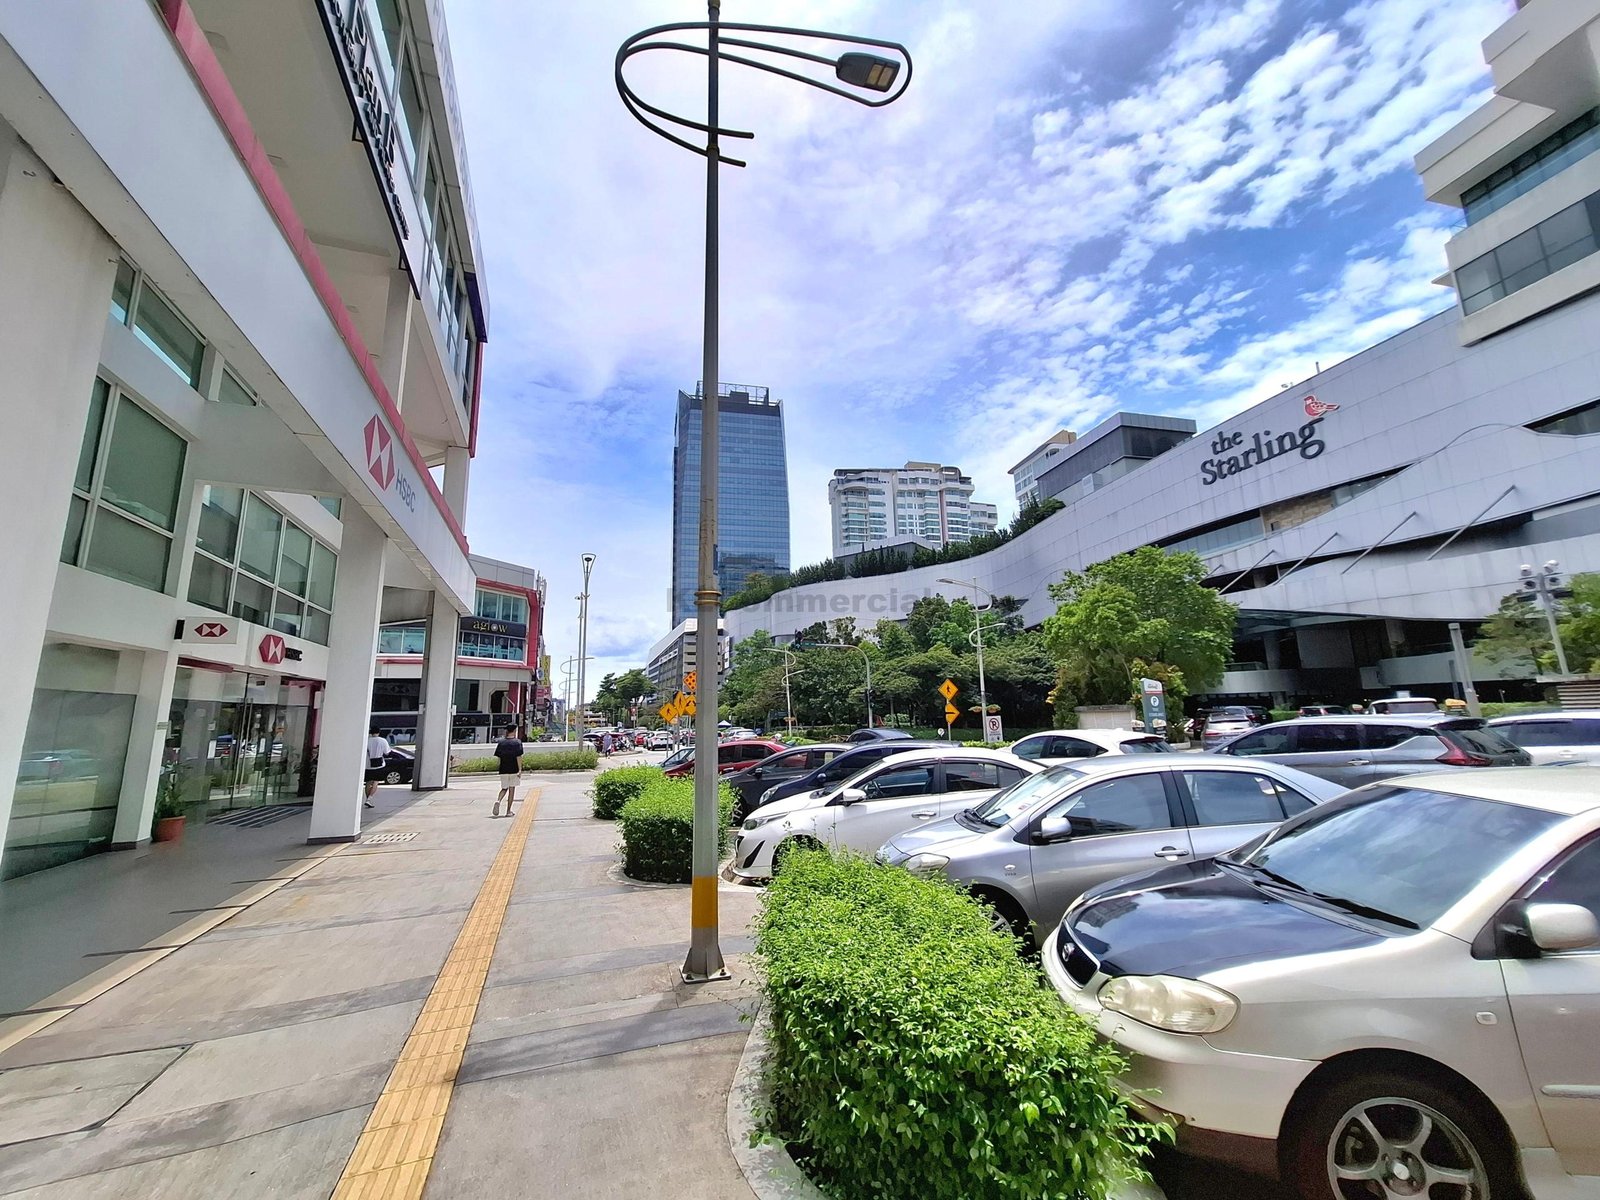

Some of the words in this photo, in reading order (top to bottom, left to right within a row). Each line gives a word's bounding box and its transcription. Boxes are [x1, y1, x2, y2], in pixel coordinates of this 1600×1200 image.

[1200, 417, 1325, 486] Starling
[1211, 431, 1243, 456] the
[395, 468, 417, 513] HSBC
